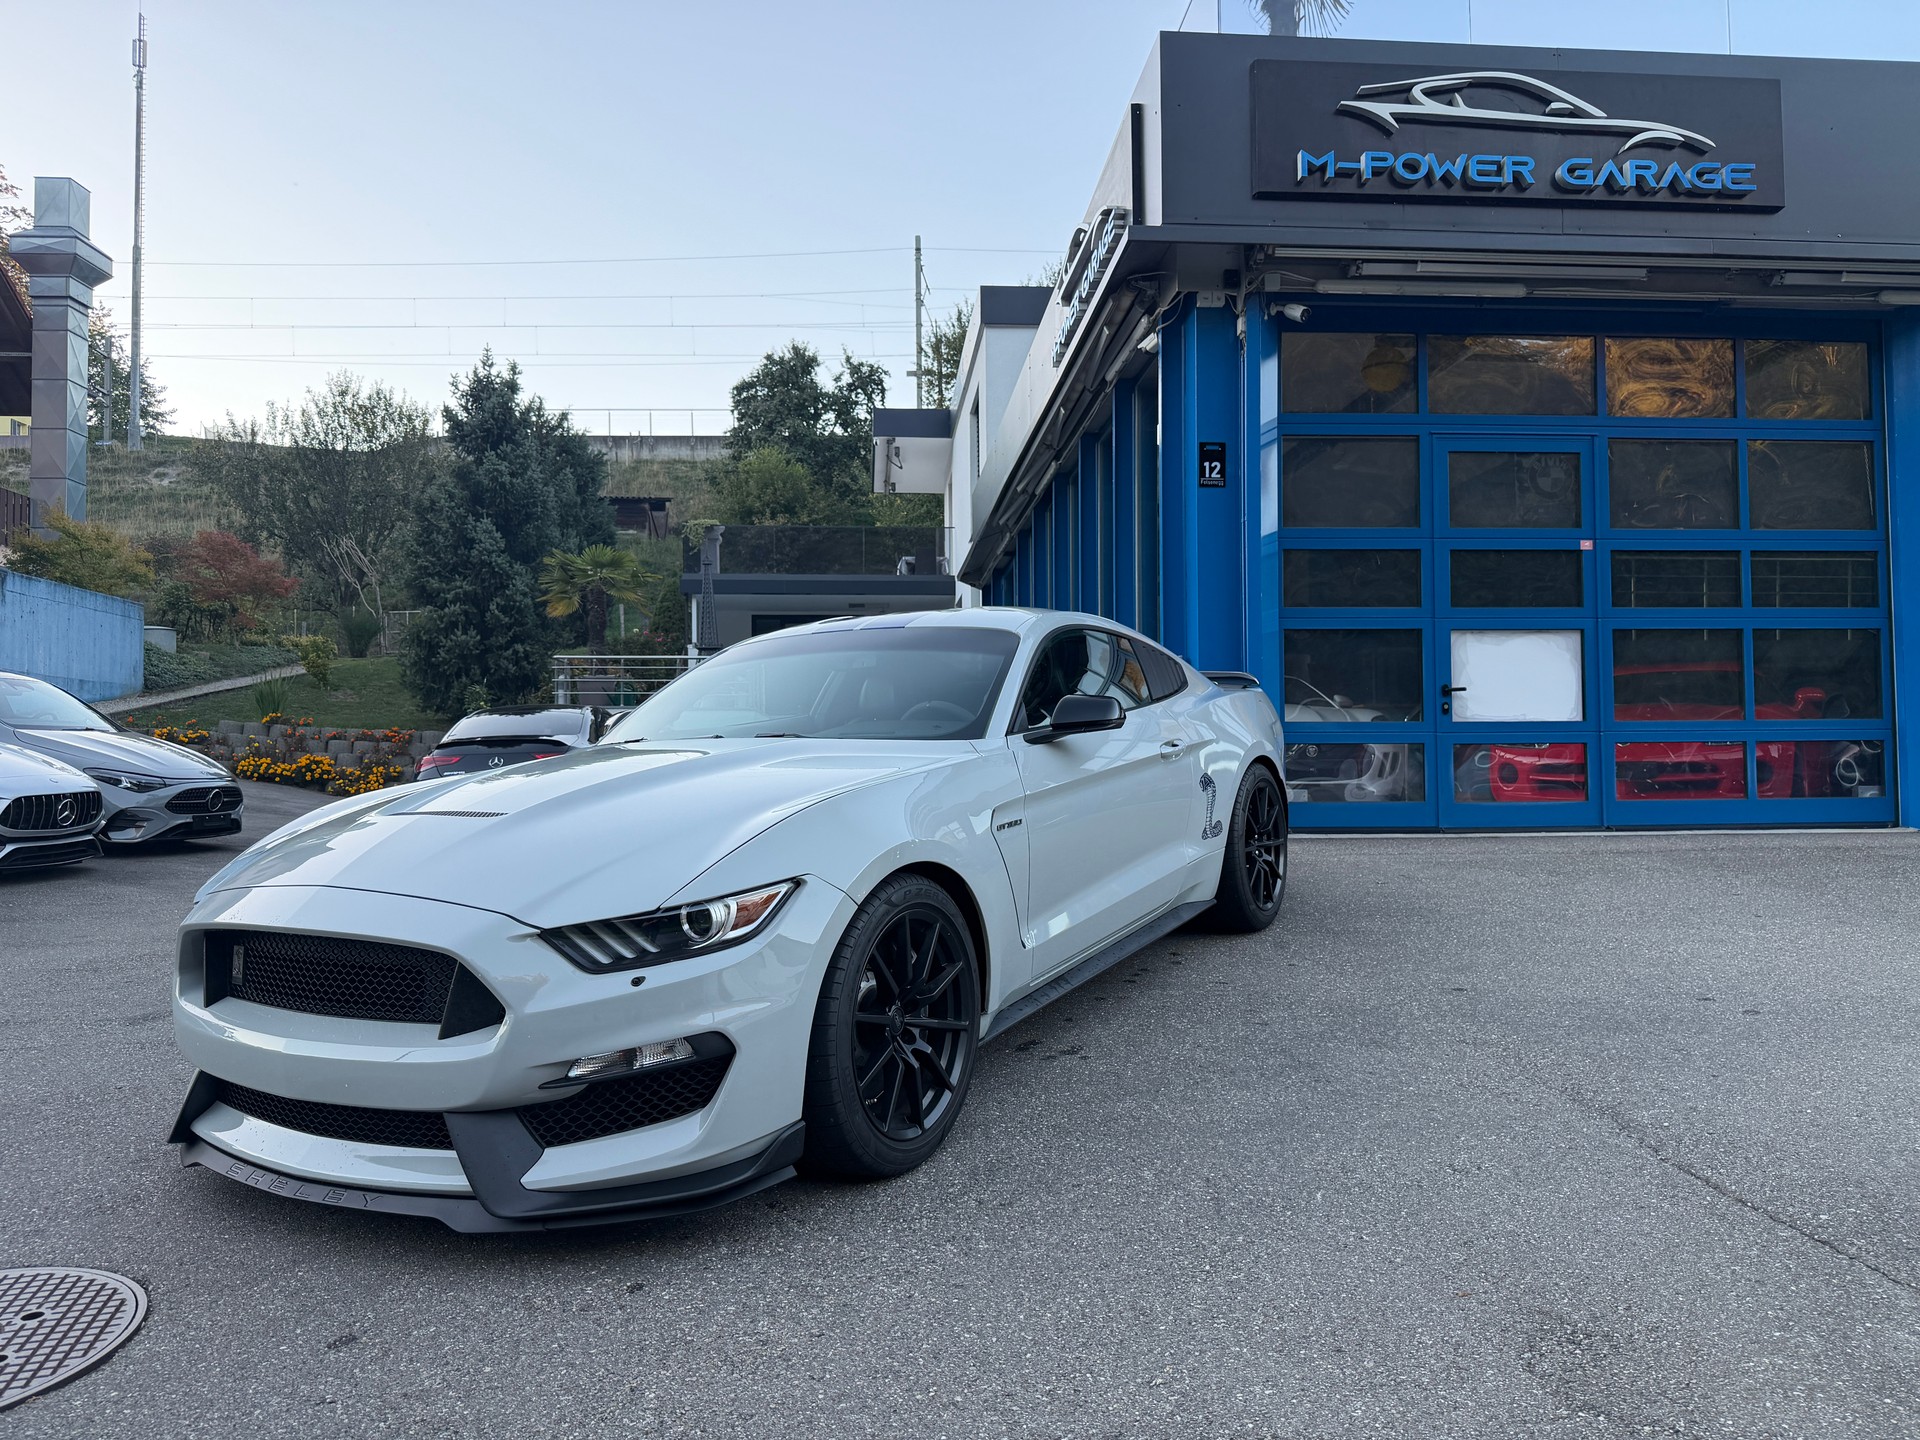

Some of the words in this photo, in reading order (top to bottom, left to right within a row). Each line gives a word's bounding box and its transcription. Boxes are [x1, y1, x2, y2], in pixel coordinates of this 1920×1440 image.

[1298, 149, 1536, 189] M-POWER
[1555, 157, 1758, 194] GARAGE
[1203, 461, 1221, 478] 12
[226, 1162, 383, 1208] SHELBY
